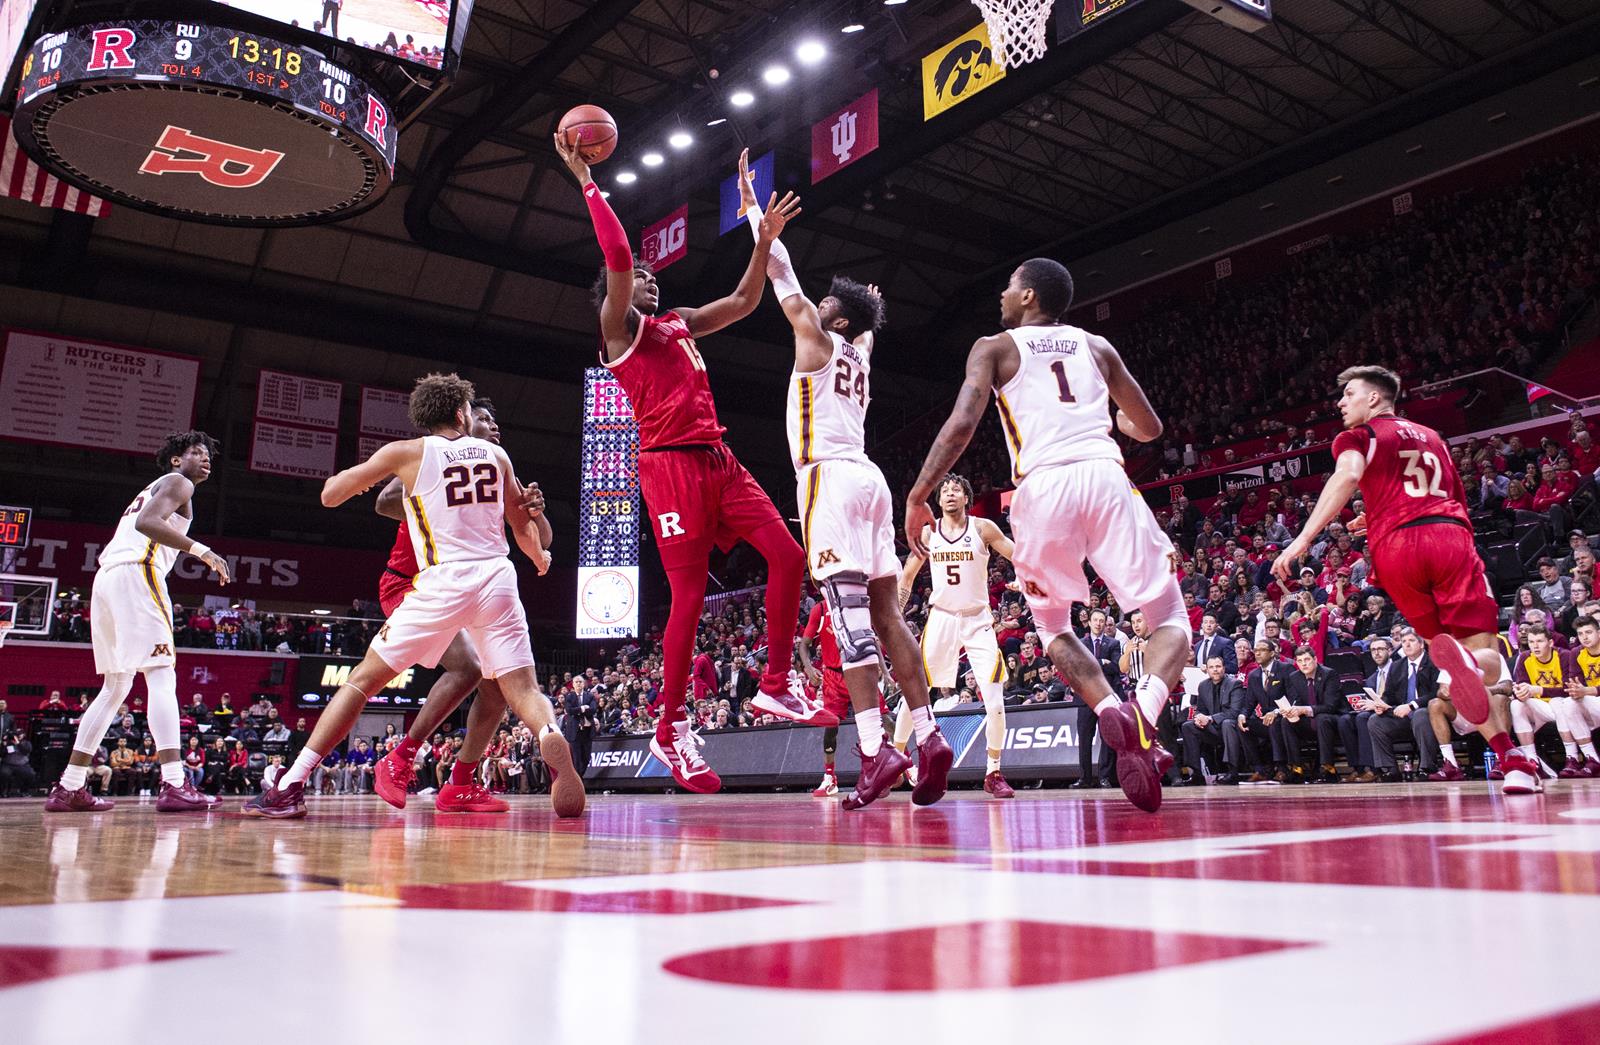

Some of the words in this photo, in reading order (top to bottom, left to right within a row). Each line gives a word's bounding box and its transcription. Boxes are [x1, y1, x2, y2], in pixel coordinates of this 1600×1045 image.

[176, 24, 200, 38] RU
[42, 32, 68, 52] MINN
[87, 28, 136, 71] R
[174, 40, 192, 60] 9
[42, 48, 62, 72] 10
[229, 36, 301, 75] 13:18
[162, 64, 186, 76] TOL
[192, 66, 201, 77] 4
[248, 70, 275, 87] 1ST
[319, 59, 350, 85] MINN
[322, 78, 346, 105] 10
[319, 100, 337, 117] TOL
[339, 110, 347, 121] 4
[364, 93, 388, 150] R
[65, 346, 146, 367] RUTGERS
[1026, 339, 1078, 355] McBRAYER
[65, 358, 77, 367] IN
[83, 361, 104, 370] THE
[110, 365, 143, 376] WNBA
[834, 358, 865, 408] 24
[1050, 361, 1076, 402] 1
[283, 464, 317, 476] SWEET
[1399, 450, 1448, 498] 32
[443, 464, 499, 507] 22
[1225, 477, 1265, 490] Horizon
[14, 512, 25, 523] 18
[590, 500, 632, 515] 13:18
[590, 515, 601, 523] RU
[590, 523, 599, 535] 9
[617, 523, 631, 535] 10
[658, 512, 685, 538] R
[932, 551, 974, 562] MINNESOTA
[946, 565, 960, 586] 5
[581, 627, 610, 635] LOCAL
[588, 751, 643, 767] NISSAN
